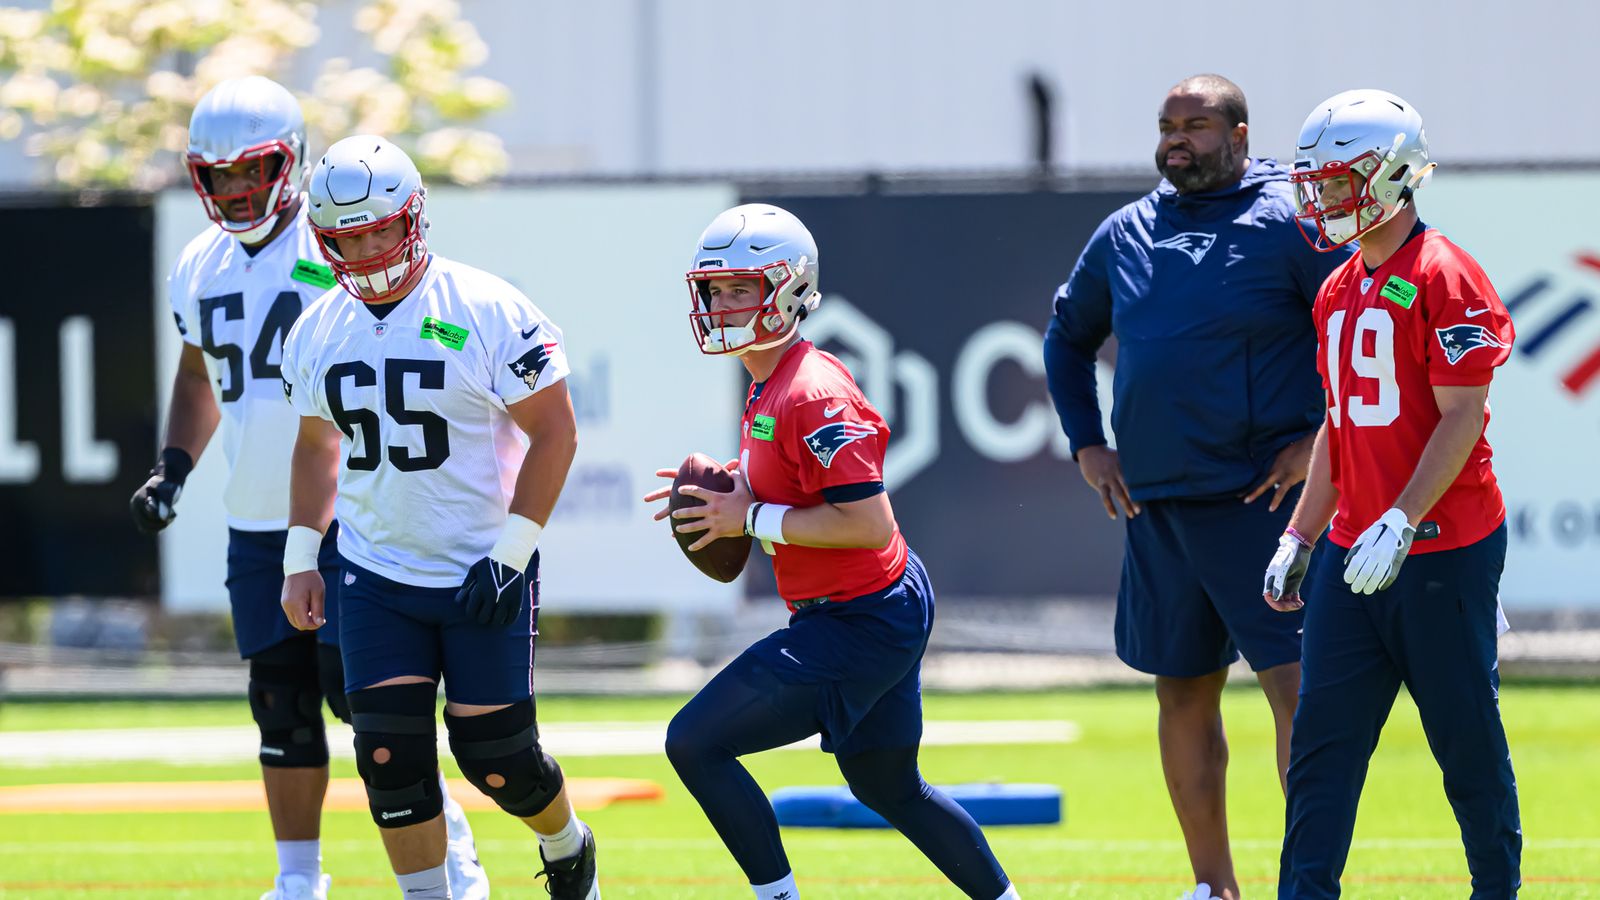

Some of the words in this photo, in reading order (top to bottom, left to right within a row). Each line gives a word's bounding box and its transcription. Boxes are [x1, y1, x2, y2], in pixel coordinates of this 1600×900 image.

[340, 214, 369, 226] PATRIOTS
[199, 291, 301, 402] 54
[1327, 307, 1400, 428] 19
[325, 358, 450, 472] 65
